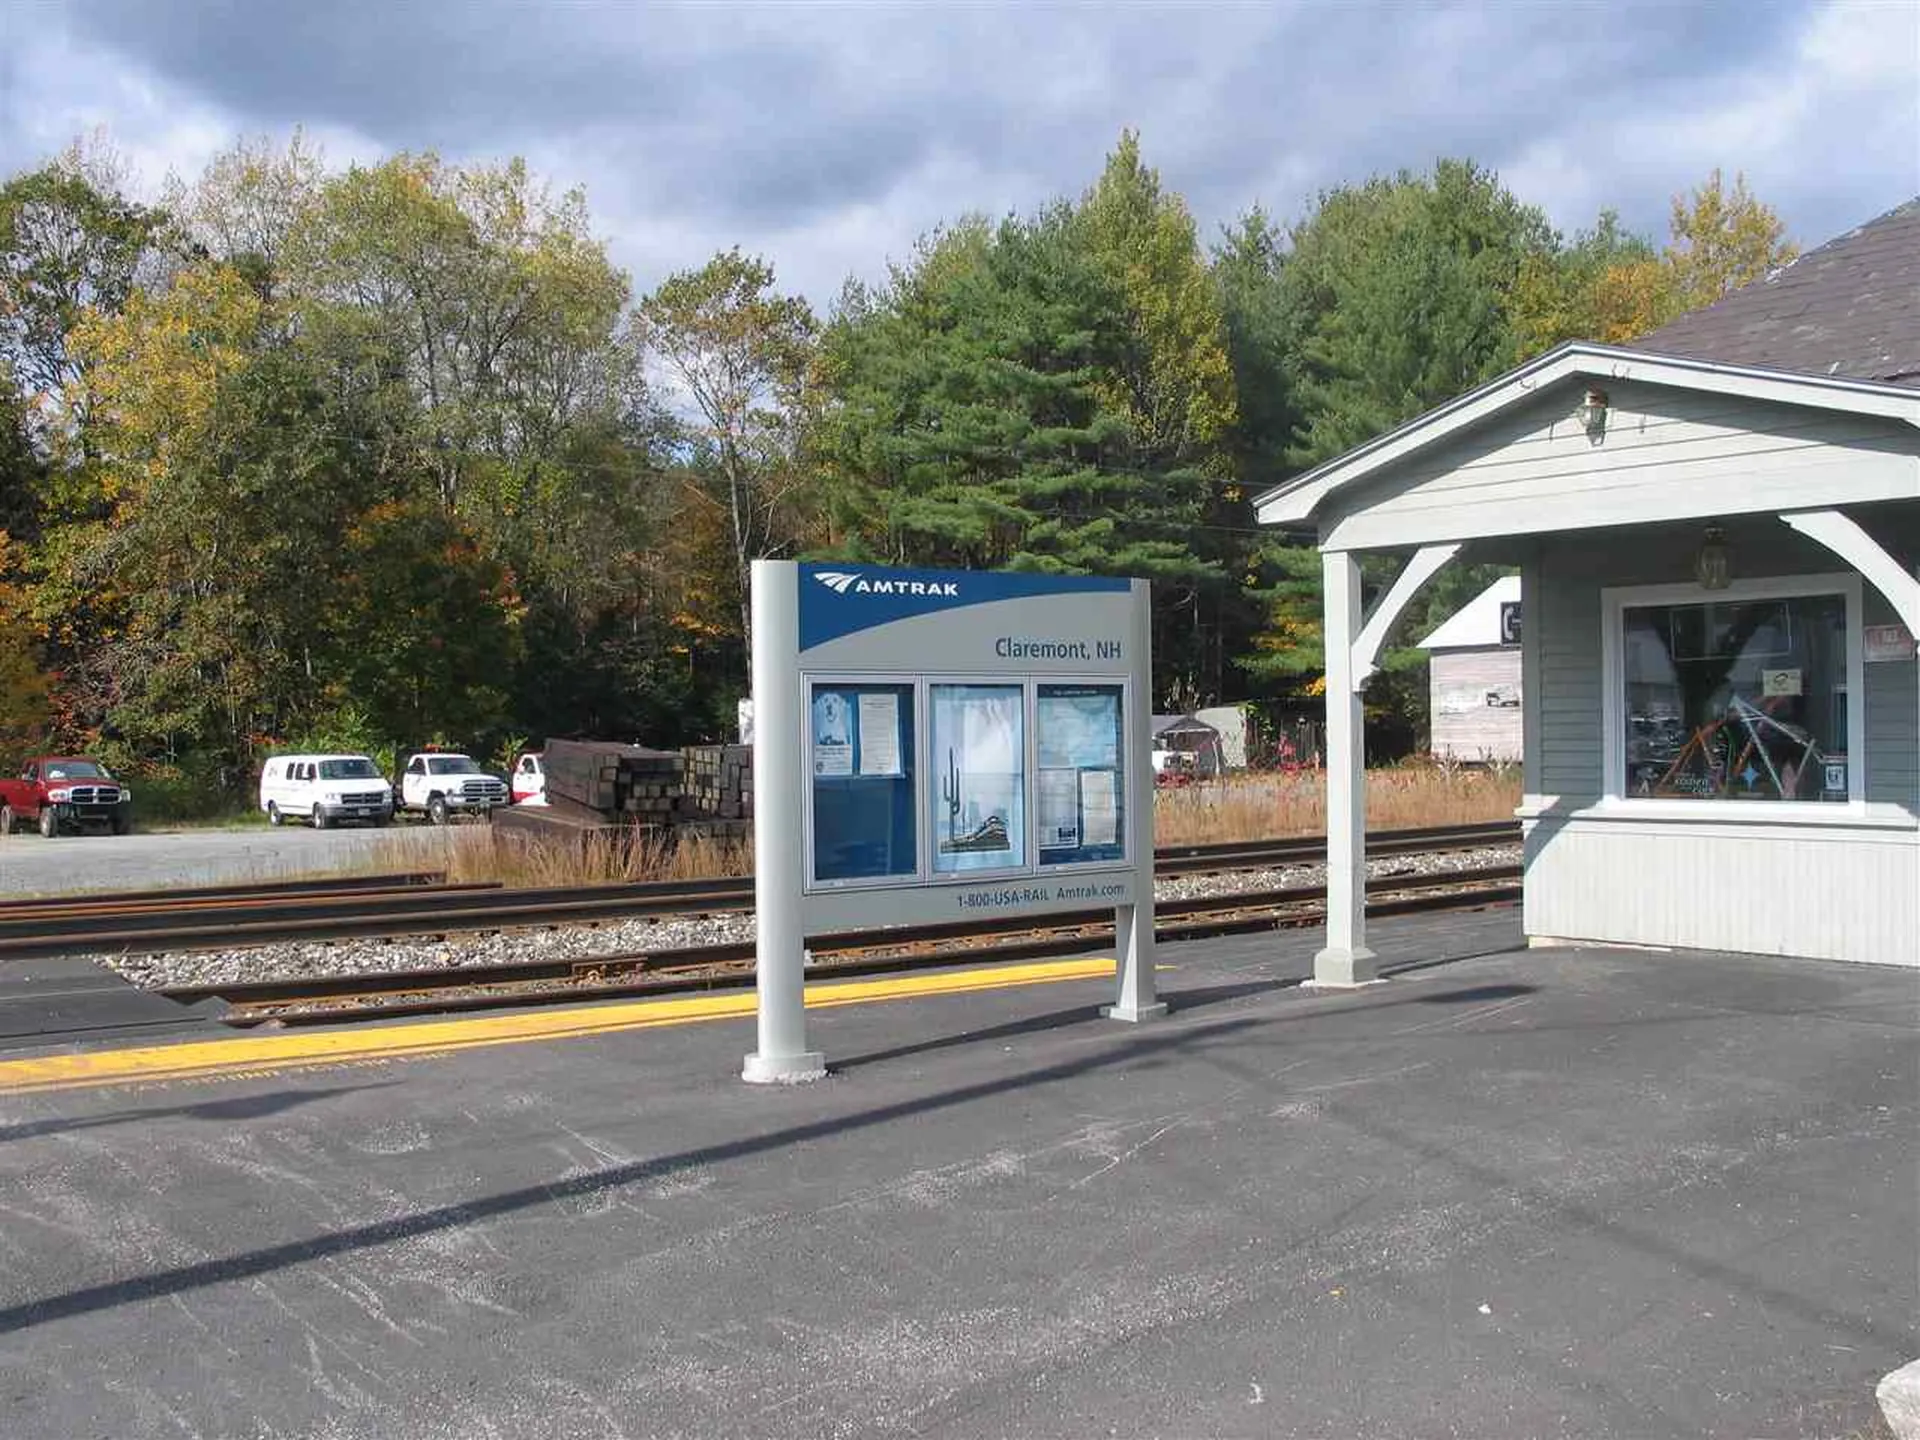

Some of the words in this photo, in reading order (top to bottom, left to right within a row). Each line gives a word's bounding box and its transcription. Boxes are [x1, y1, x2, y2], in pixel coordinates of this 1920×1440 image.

[857, 580, 958, 596] AMTRAK
[995, 637, 1091, 660] Claremont,
[1097, 642, 1121, 659] NH
[958, 891, 1048, 907] 1-800-USA-RAIL
[1057, 885, 1124, 899] Amtrak.com
